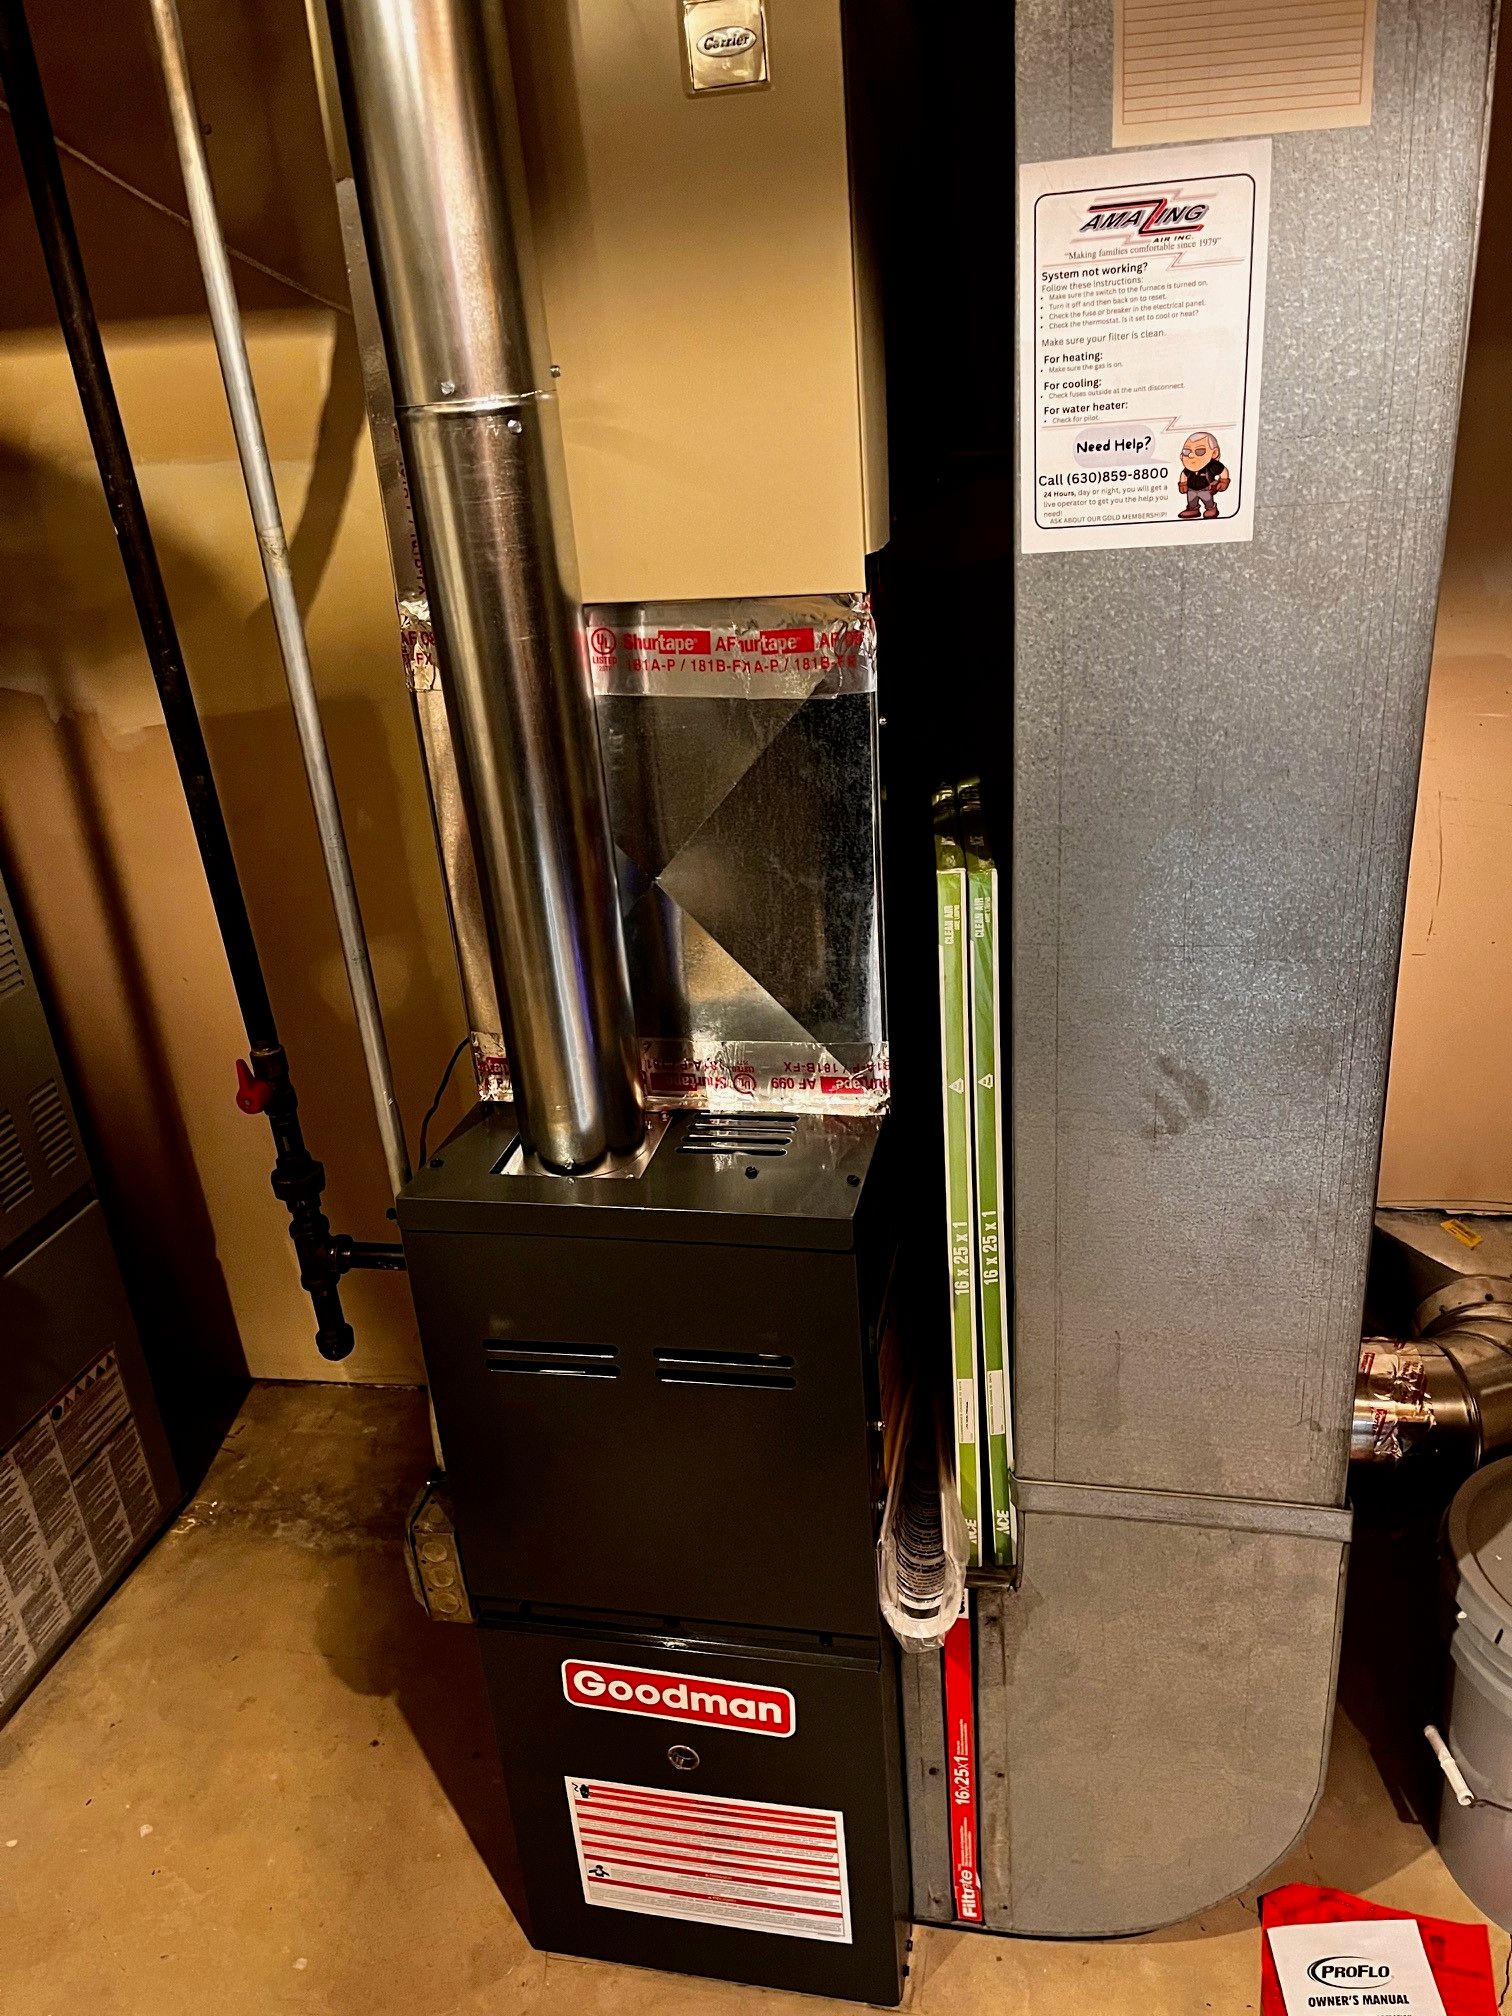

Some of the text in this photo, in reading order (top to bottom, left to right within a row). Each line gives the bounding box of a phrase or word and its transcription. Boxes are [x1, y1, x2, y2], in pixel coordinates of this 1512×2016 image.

[703, 34, 750, 51] Carrier
[1079, 198, 1210, 237] AMAZING
[1153, 234, 1194, 244] AIR INC.
[1098, 248, 1128, 258] families
[1129, 244, 1175, 255] comfortable
[1177, 241, 1197, 250] since
[1041, 261, 1148, 282] System not working?
[1042, 277, 1144, 293] Follow these instructions:
[1050, 293, 1067, 301] Make
[1083, 290, 1094, 298] the
[1095, 289, 1117, 297] switch
[1127, 286, 1138, 294] the
[1139, 284, 1165, 293] furnace
[1173, 281, 1195, 289] turned
[1049, 312, 1069, 320] Check
[1082, 309, 1097, 317] fuse
[1106, 306, 1131, 314] breaker
[1153, 301, 1184, 310] electrical
[1071, 301, 1081, 309] off
[1082, 300, 1095, 308] and
[1096, 298, 1111, 306] then
[1049, 322, 1069, 330] Check
[1070, 320, 1081, 328] the
[1155, 312, 1170, 320] cool
[1180, 309, 1199, 317] heat?
[1042, 329, 1168, 347] Make sure your filter is clean.
[1044, 351, 1103, 364] For heating:
[1082, 363, 1093, 371] the
[1094, 363, 1106, 371] gas
[1044, 378, 1102, 391] For cooling:
[1049, 392, 1069, 400] Check
[1069, 390, 1087, 399] fuses
[1088, 388, 1112, 396] outside
[1133, 385, 1147, 393] unit
[1044, 400, 1129, 416] For water heater:
[1076, 436, 1152, 454] Need Help?
[1038, 467, 1169, 486] Call (630)859-8800
[1053, 490, 1077, 498] Hours,
[1078, 488, 1091, 498] day
[1101, 487, 1121, 497] night,
[1122, 486, 1136, 496] you
[1136, 485, 1150, 493] will
[1150, 484, 1162, 494] get
[1043, 493, 1169, 509] live operator to get you the help you
[1043, 510, 1063, 518] need!
[1063, 516, 1086, 524] ABOUT
[1086, 514, 1101, 523] OUR
[1101, 513, 1121, 522] GOLD
[1121, 511, 1168, 520] MEMBERSHIP!
[974, 897, 985, 938] CLEAN AIR
[944, 920, 955, 945] CLEAN
[783, 1060, 839, 1074] 181B-FX
[771, 1077, 816, 1090] AF 099
[981, 1210, 999, 1286] 16 x 25 x 1
[952, 1221, 970, 1296] 16 x 25 x 1
[996, 1509, 1010, 1535] ACE
[573, 1669, 783, 1724] Goodman
[953, 1755, 971, 1806] 16x25x1
[1308, 1994, 1410, 2008] OWNER'S MANUAL
